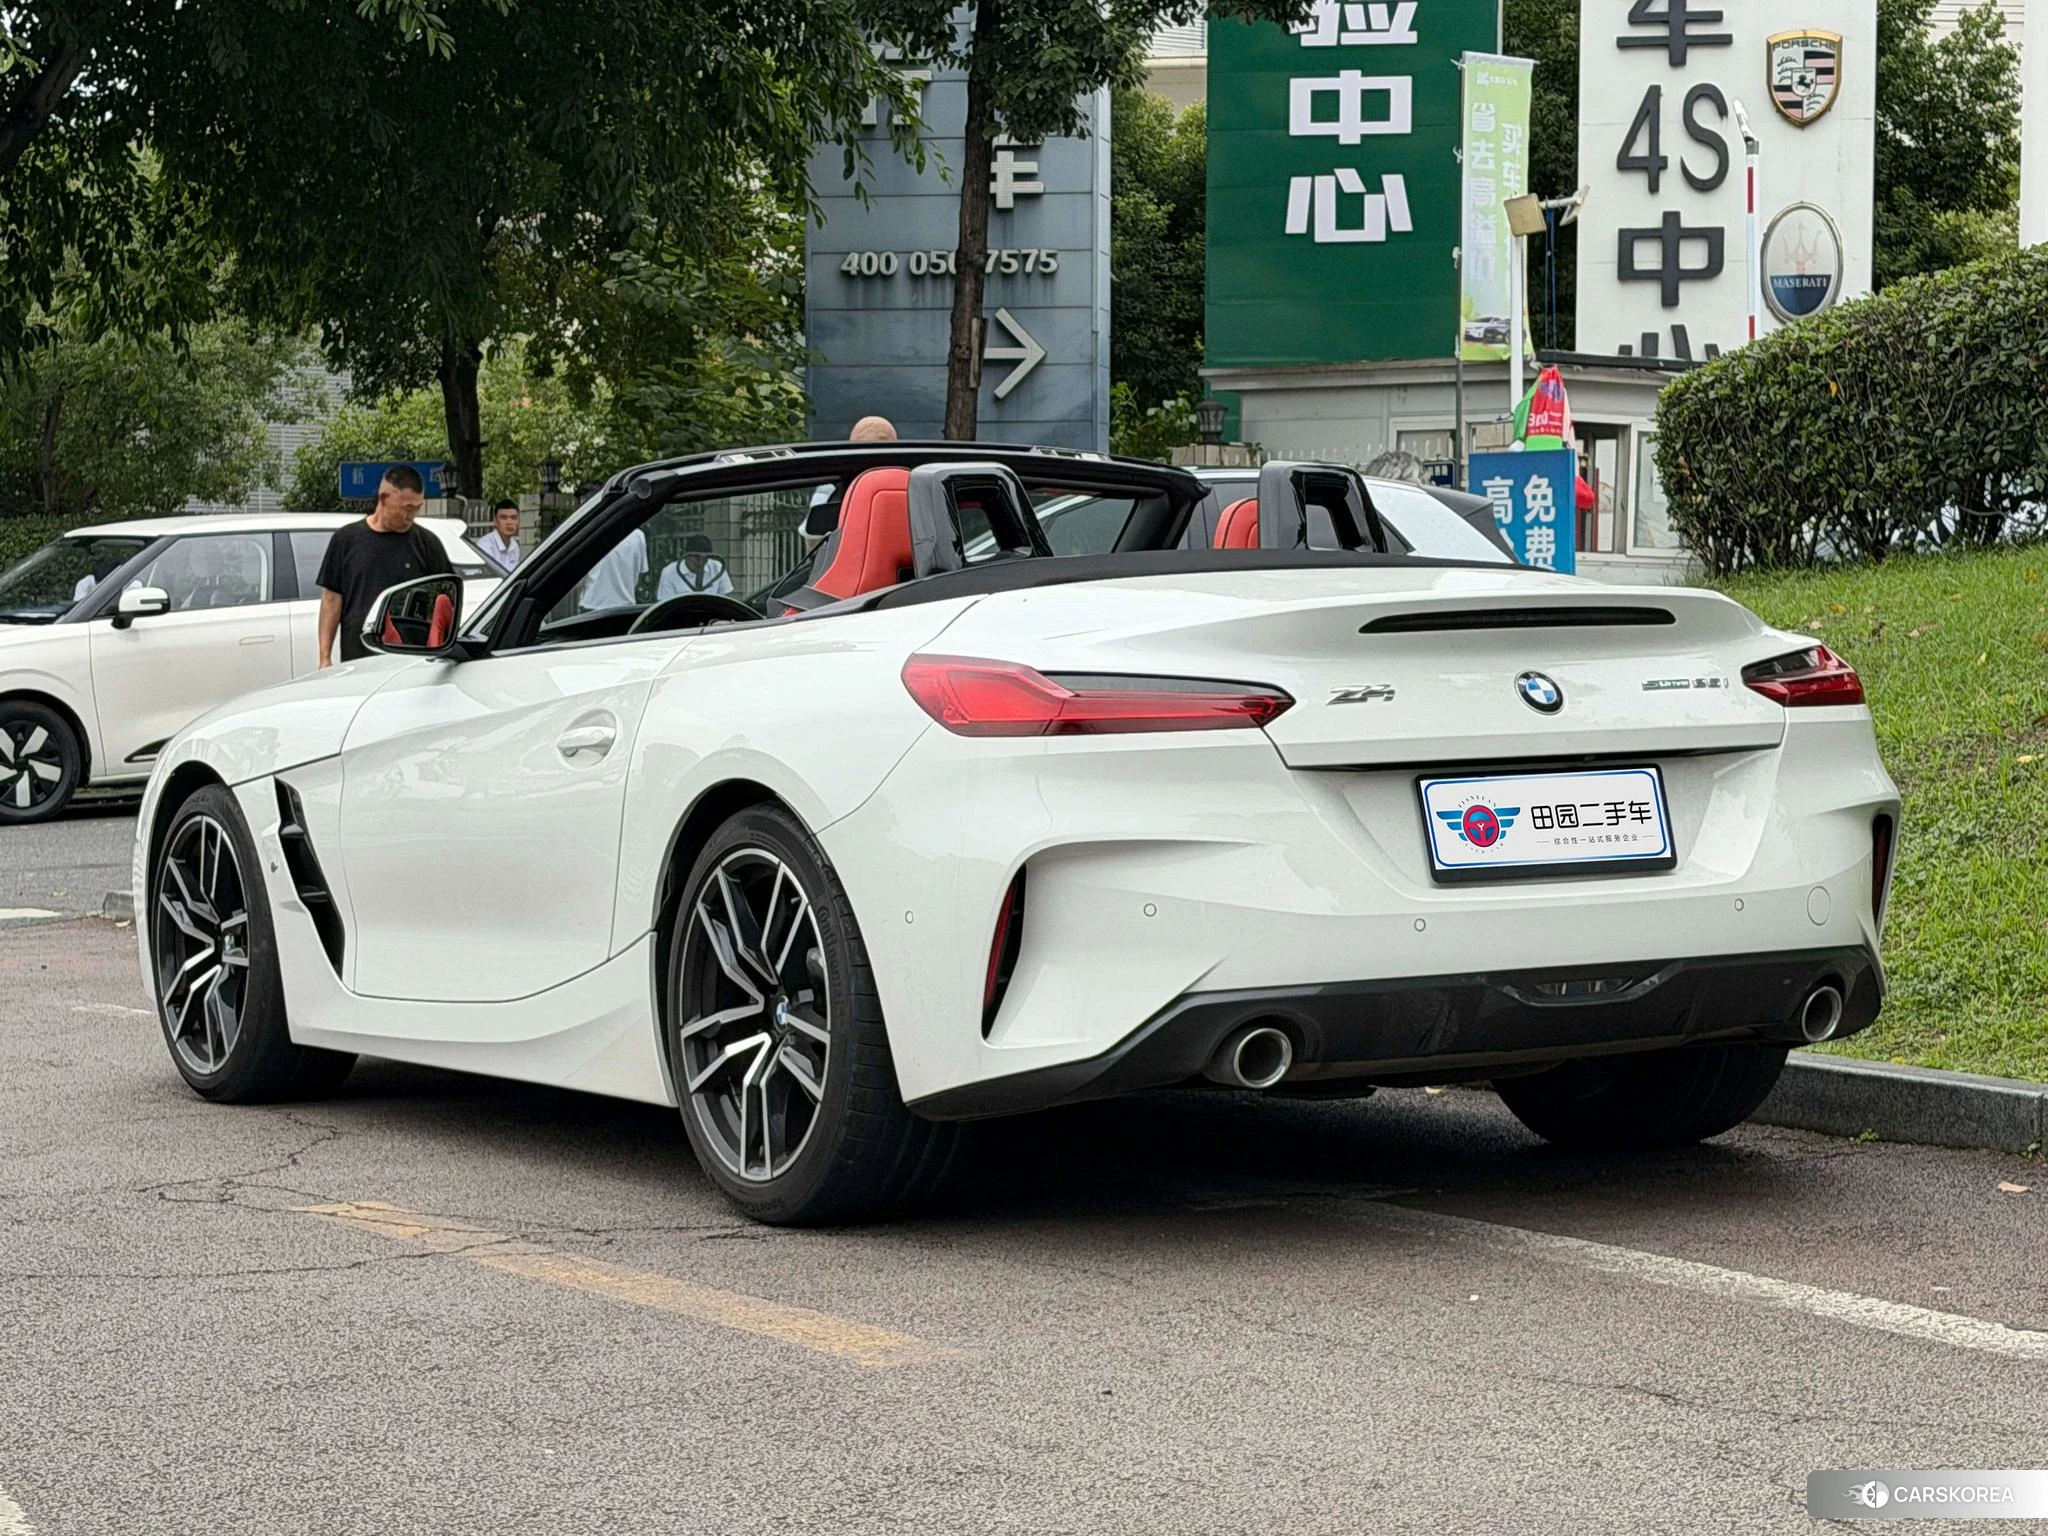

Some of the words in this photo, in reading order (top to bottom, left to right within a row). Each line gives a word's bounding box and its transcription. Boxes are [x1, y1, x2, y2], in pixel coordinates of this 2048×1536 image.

[1772, 40, 1837, 51] PORSCHE
[840, 250, 899, 276] 400
[909, 250, 957, 275] 05
[984, 248, 1058, 275] 7575
[1773, 277, 1828, 288] MASERATI
[1523, 474, 1557, 571] 免费
[1326, 684, 1396, 706] Z4
[1530, 800, 1653, 830] 田园二手车
